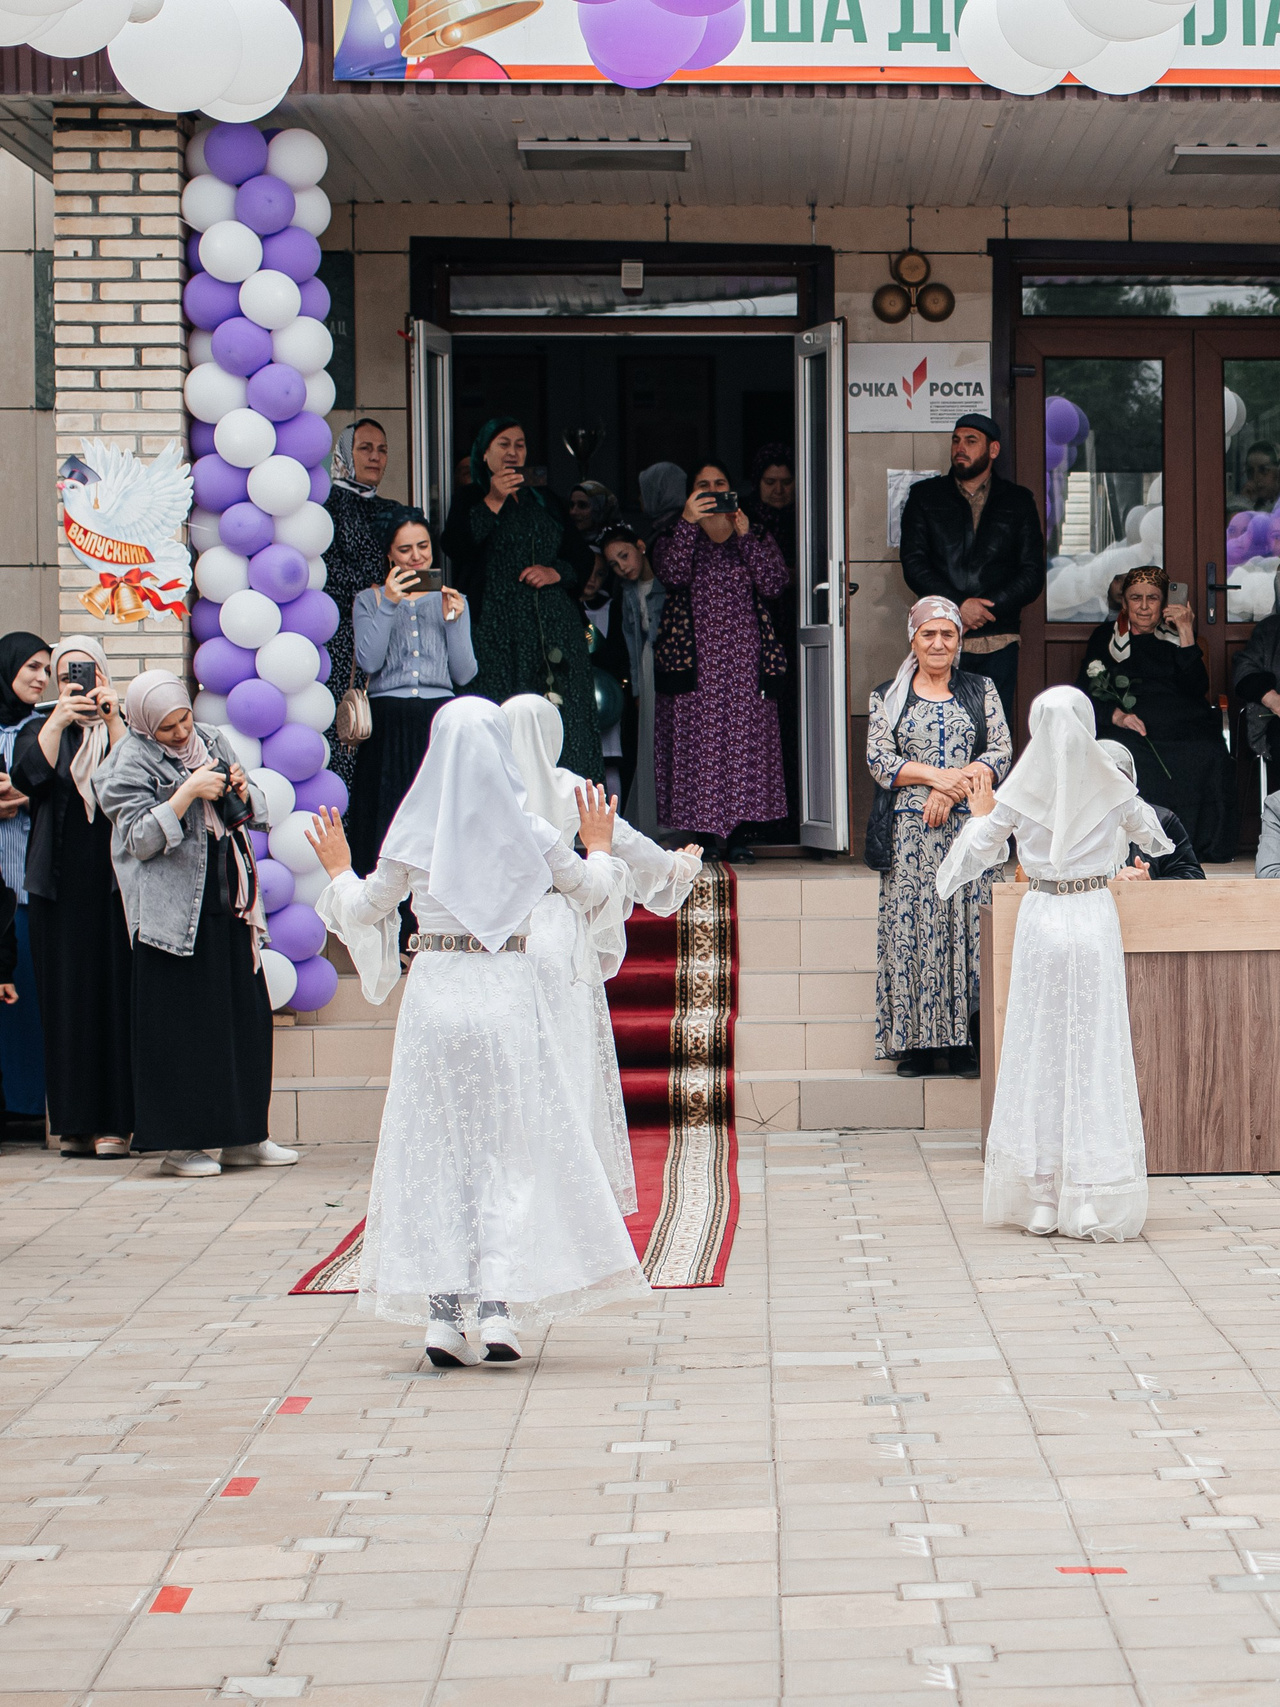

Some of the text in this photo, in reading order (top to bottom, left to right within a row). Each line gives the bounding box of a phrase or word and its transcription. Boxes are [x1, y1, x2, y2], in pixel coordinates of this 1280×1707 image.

[751, 0, 868, 43] ША
[849, 382, 984, 397] ОЧКА РОСТА
[67, 522, 150, 565] ВЫПУСКНИК
